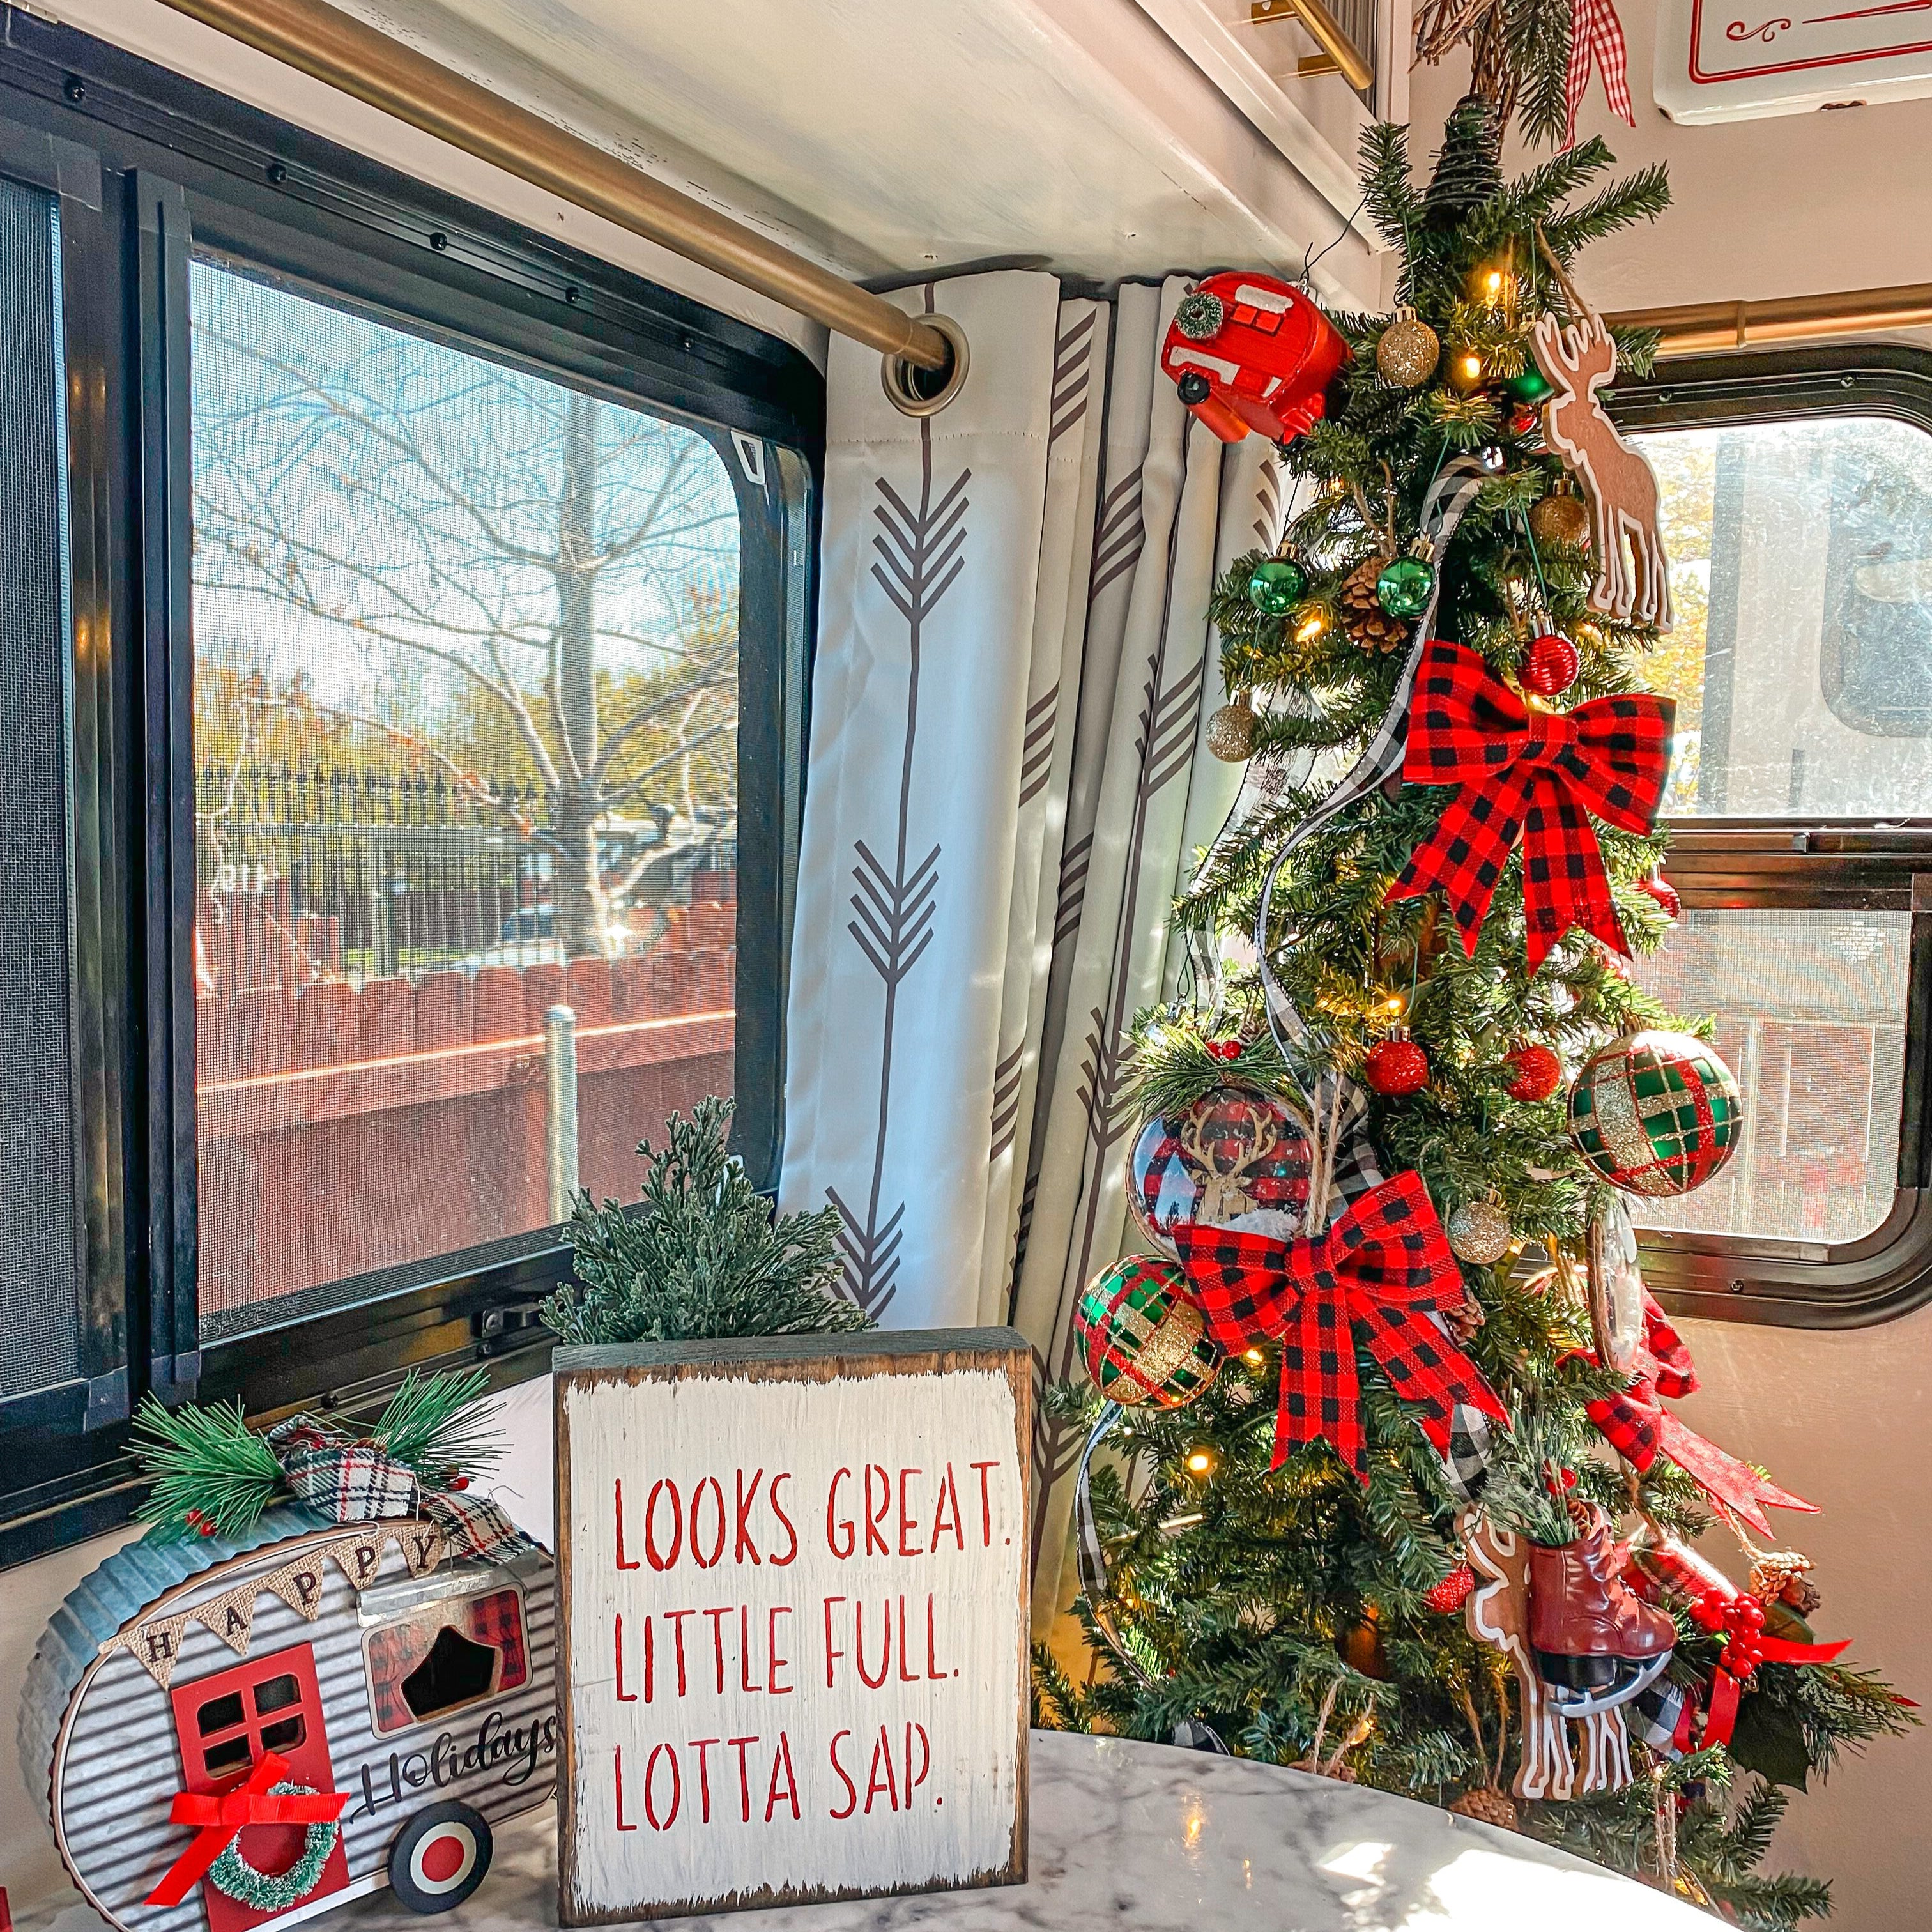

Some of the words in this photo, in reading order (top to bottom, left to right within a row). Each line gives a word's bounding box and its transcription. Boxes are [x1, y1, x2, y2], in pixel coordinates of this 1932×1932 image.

[615, 1468, 798, 1572] LOOKS
[827, 1461, 1010, 1560] GREAT.
[146, 1535, 437, 1662] HAPPY
[615, 1605, 793, 1704] LITTLE
[824, 1593, 960, 1690] FULL.
[349, 1711, 557, 1824] Holidays
[615, 1730, 801, 1832] LOTTA
[829, 1721, 943, 1820] SAP.
